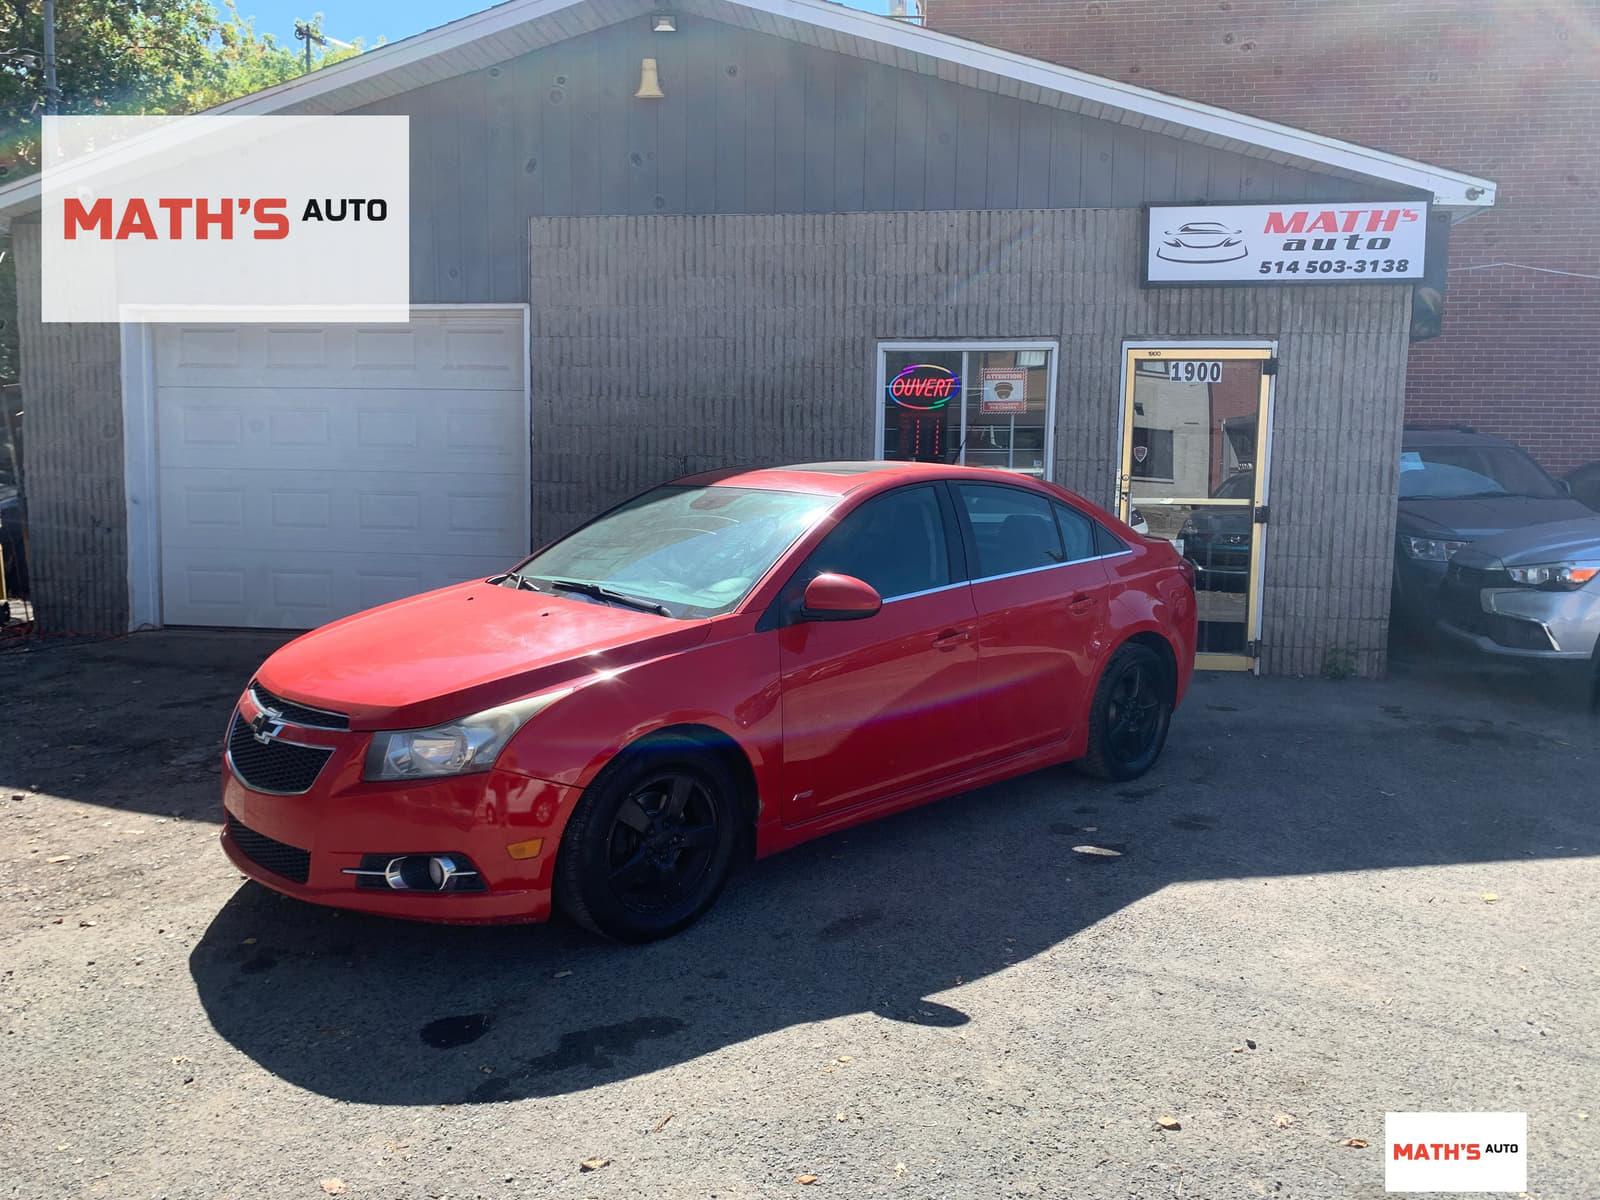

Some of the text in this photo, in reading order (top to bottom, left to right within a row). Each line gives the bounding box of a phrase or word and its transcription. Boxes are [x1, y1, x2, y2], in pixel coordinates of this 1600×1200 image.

[1282, 234, 1391, 251] auto
[1259, 259, 1409, 274] 514 503-3138
[1171, 362, 1221, 381] 1900
[892, 378, 955, 397] OUVERT
